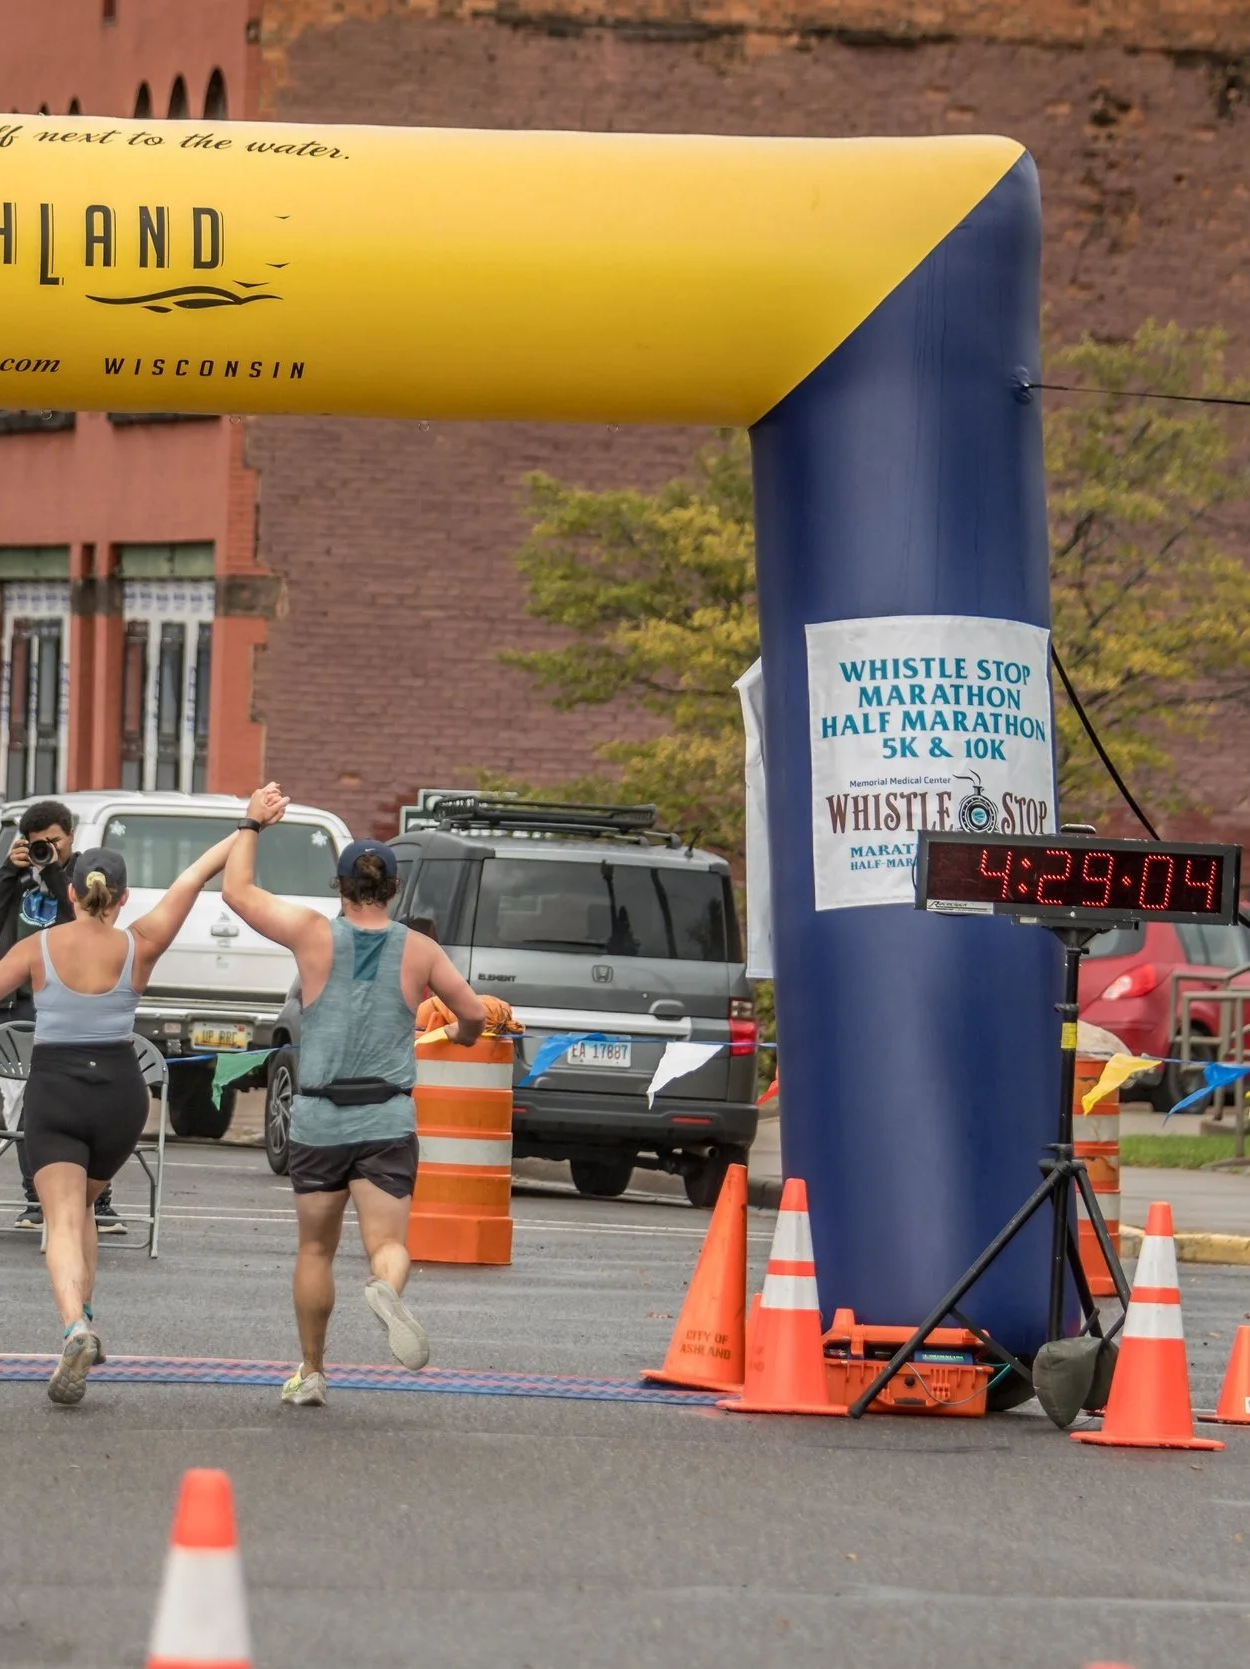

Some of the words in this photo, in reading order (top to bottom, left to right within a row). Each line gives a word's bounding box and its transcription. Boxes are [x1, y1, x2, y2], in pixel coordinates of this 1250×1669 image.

[32, 128, 121, 146] next
[127, 131, 165, 146] to
[179, 132, 233, 149] the
[246, 139, 350, 161] water.
[104, 356, 306, 380] WISCONSIN
[839, 657, 968, 682] WHISTLE
[977, 659, 1031, 685] STOP
[858, 683, 1021, 711] MARATHON
[821, 711, 891, 738] HALF
[901, 710, 1046, 742] MARATHON
[882, 736, 919, 759] 5K
[929, 736, 954, 758] &
[964, 738, 1006, 760] 10K
[850, 778, 888, 788] Memorial
[890, 776, 922, 786] Medical
[923, 776, 951, 785] Center
[825, 791, 954, 834] WHISTLE
[1001, 791, 1048, 835] STOP
[850, 843, 918, 858] MARAT
[686, 1330, 712, 1342] CITY
[714, 1333, 728, 1345] OF
[680, 1344, 731, 1360] ASHLAND
